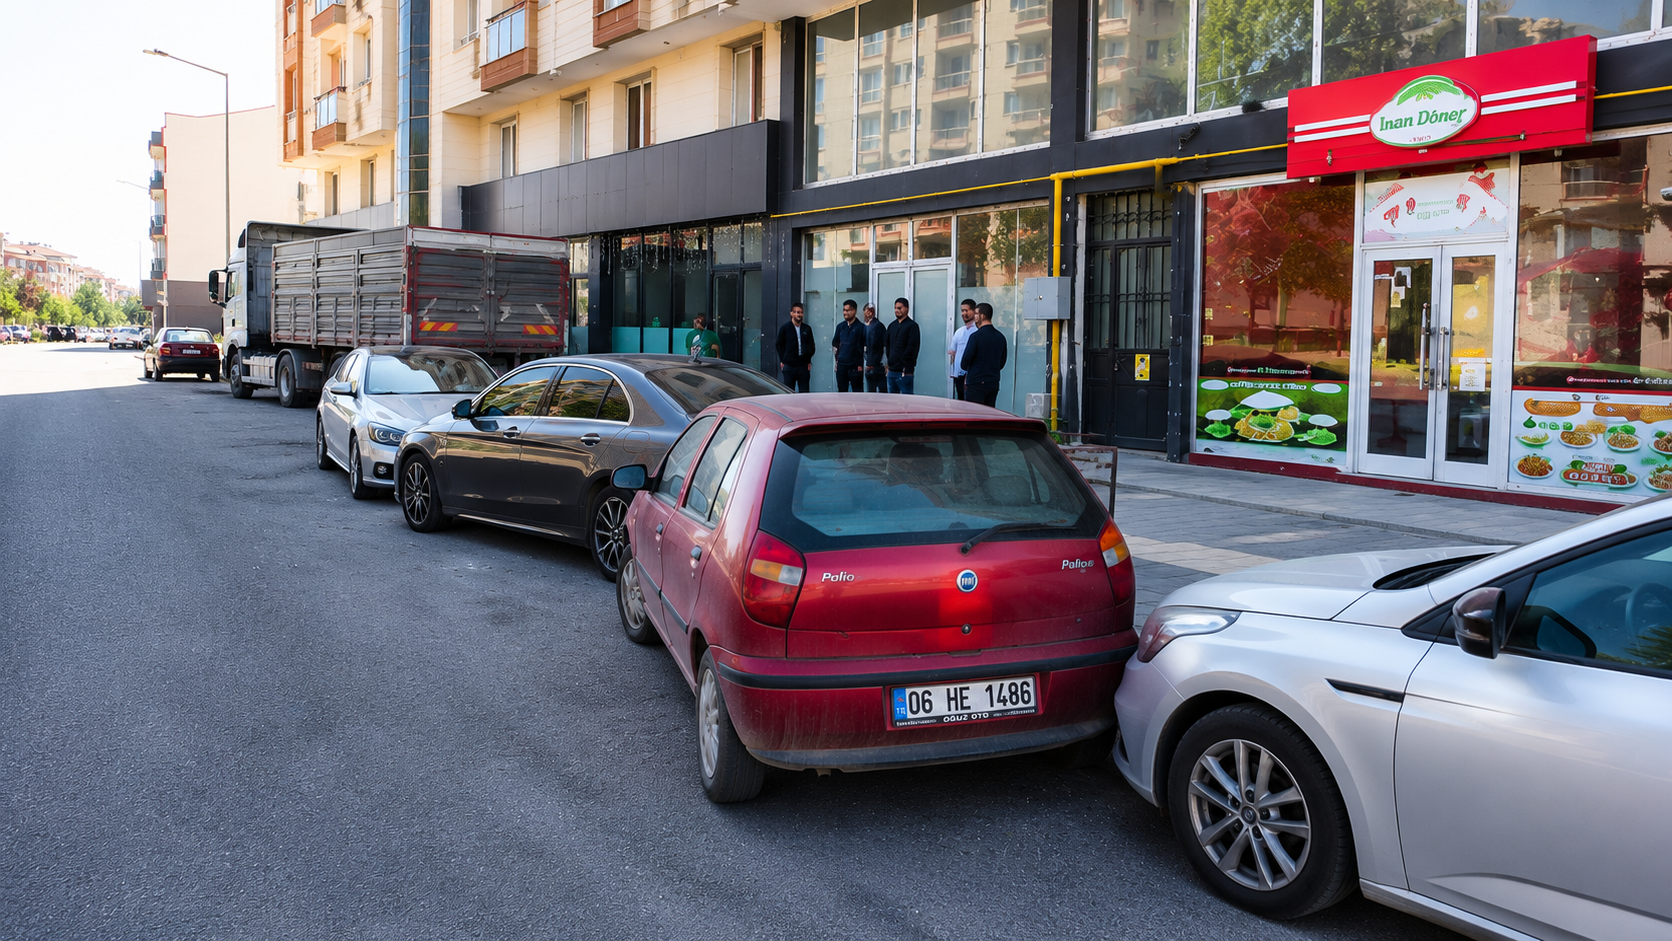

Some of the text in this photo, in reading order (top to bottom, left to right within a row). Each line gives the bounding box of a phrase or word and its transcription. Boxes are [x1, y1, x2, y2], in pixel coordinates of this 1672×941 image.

[1379, 116, 1413, 132] Inan
[821, 571, 855, 582] Palio
[908, 690, 933, 715] 06
[946, 686, 971, 711] HE
[985, 681, 1032, 708] 1486
